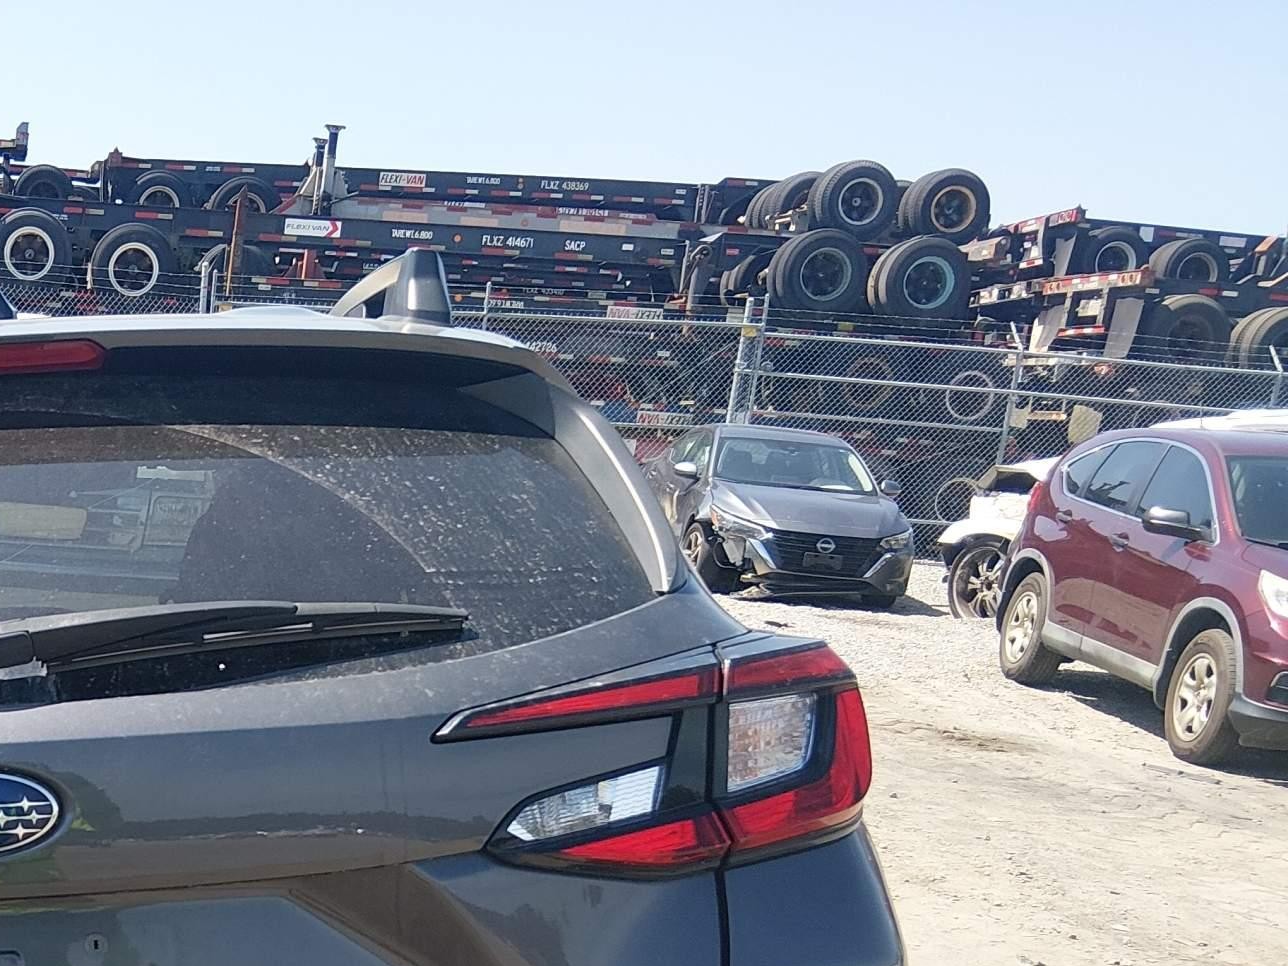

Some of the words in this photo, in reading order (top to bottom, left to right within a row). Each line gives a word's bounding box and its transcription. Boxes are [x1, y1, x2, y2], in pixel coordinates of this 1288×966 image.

[380, 173, 425, 185] FLEXI-VAN
[540, 180, 559, 190] FLXZ
[561, 181, 589, 191] 438369
[481, 234, 505, 246] FLXZ
[505, 236, 534, 248] 414671
[564, 239, 586, 251] SACP
